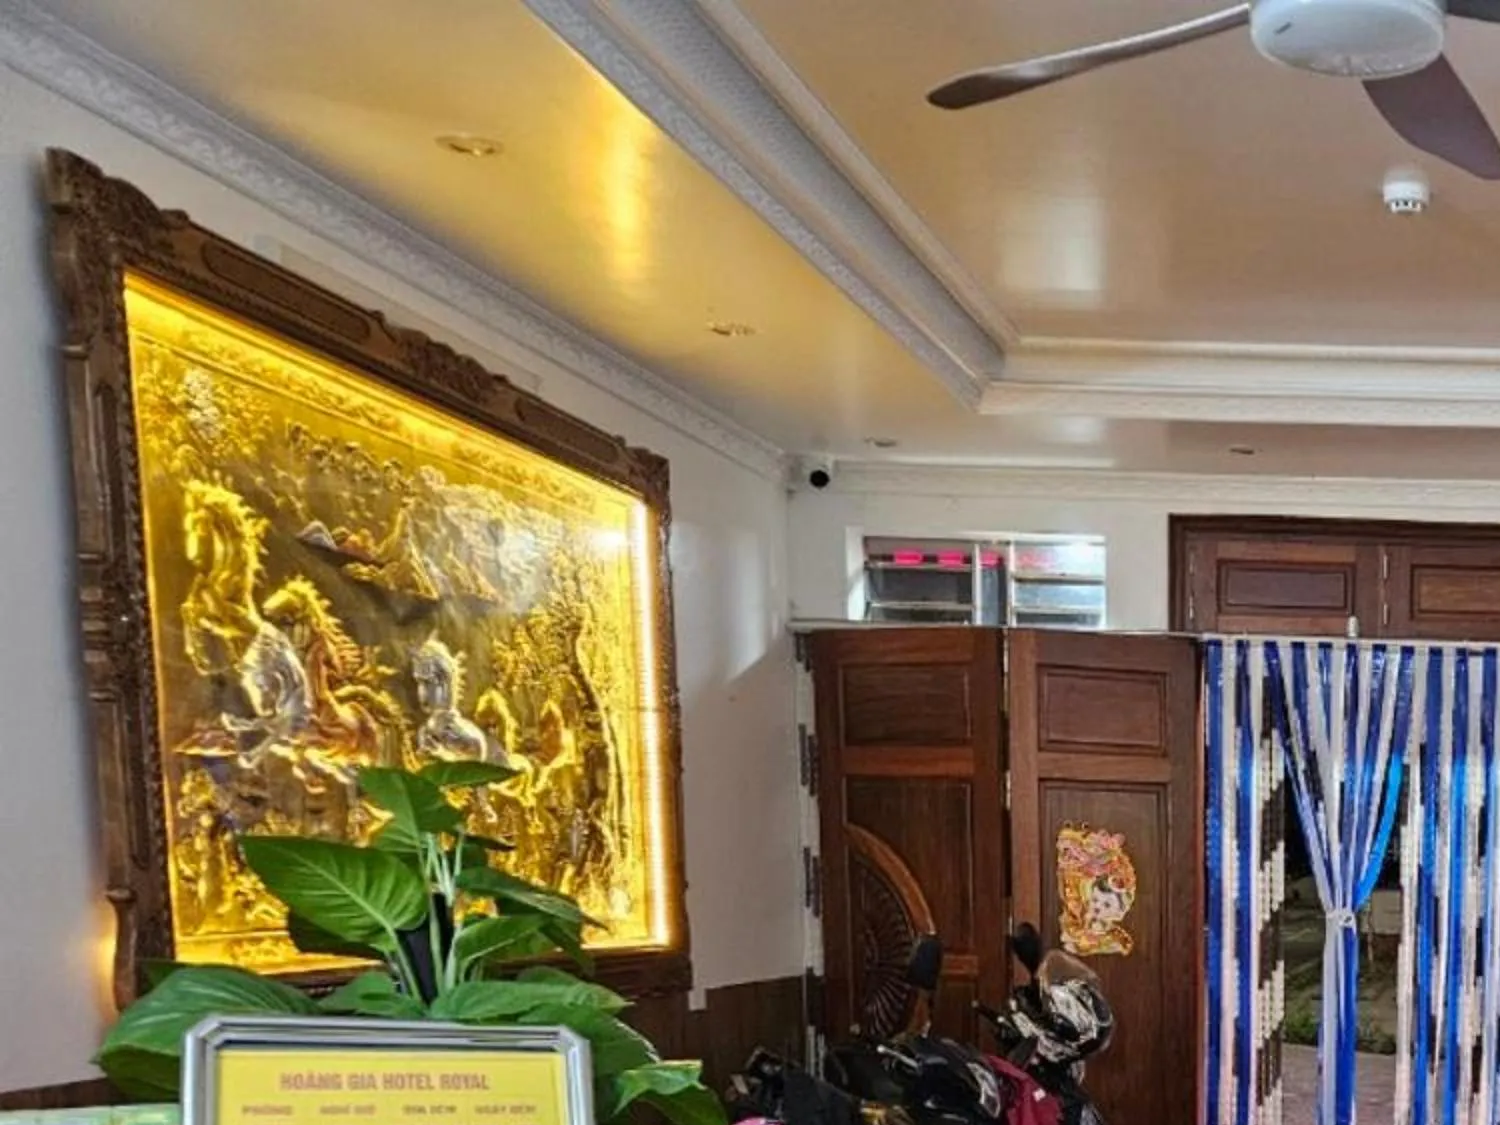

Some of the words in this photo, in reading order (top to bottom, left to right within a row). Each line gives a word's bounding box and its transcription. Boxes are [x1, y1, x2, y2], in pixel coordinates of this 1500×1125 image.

[348, 1073, 378, 1090] GIA
[383, 1073, 434, 1090] HOTEL
[440, 1073, 490, 1090] ROYAL
